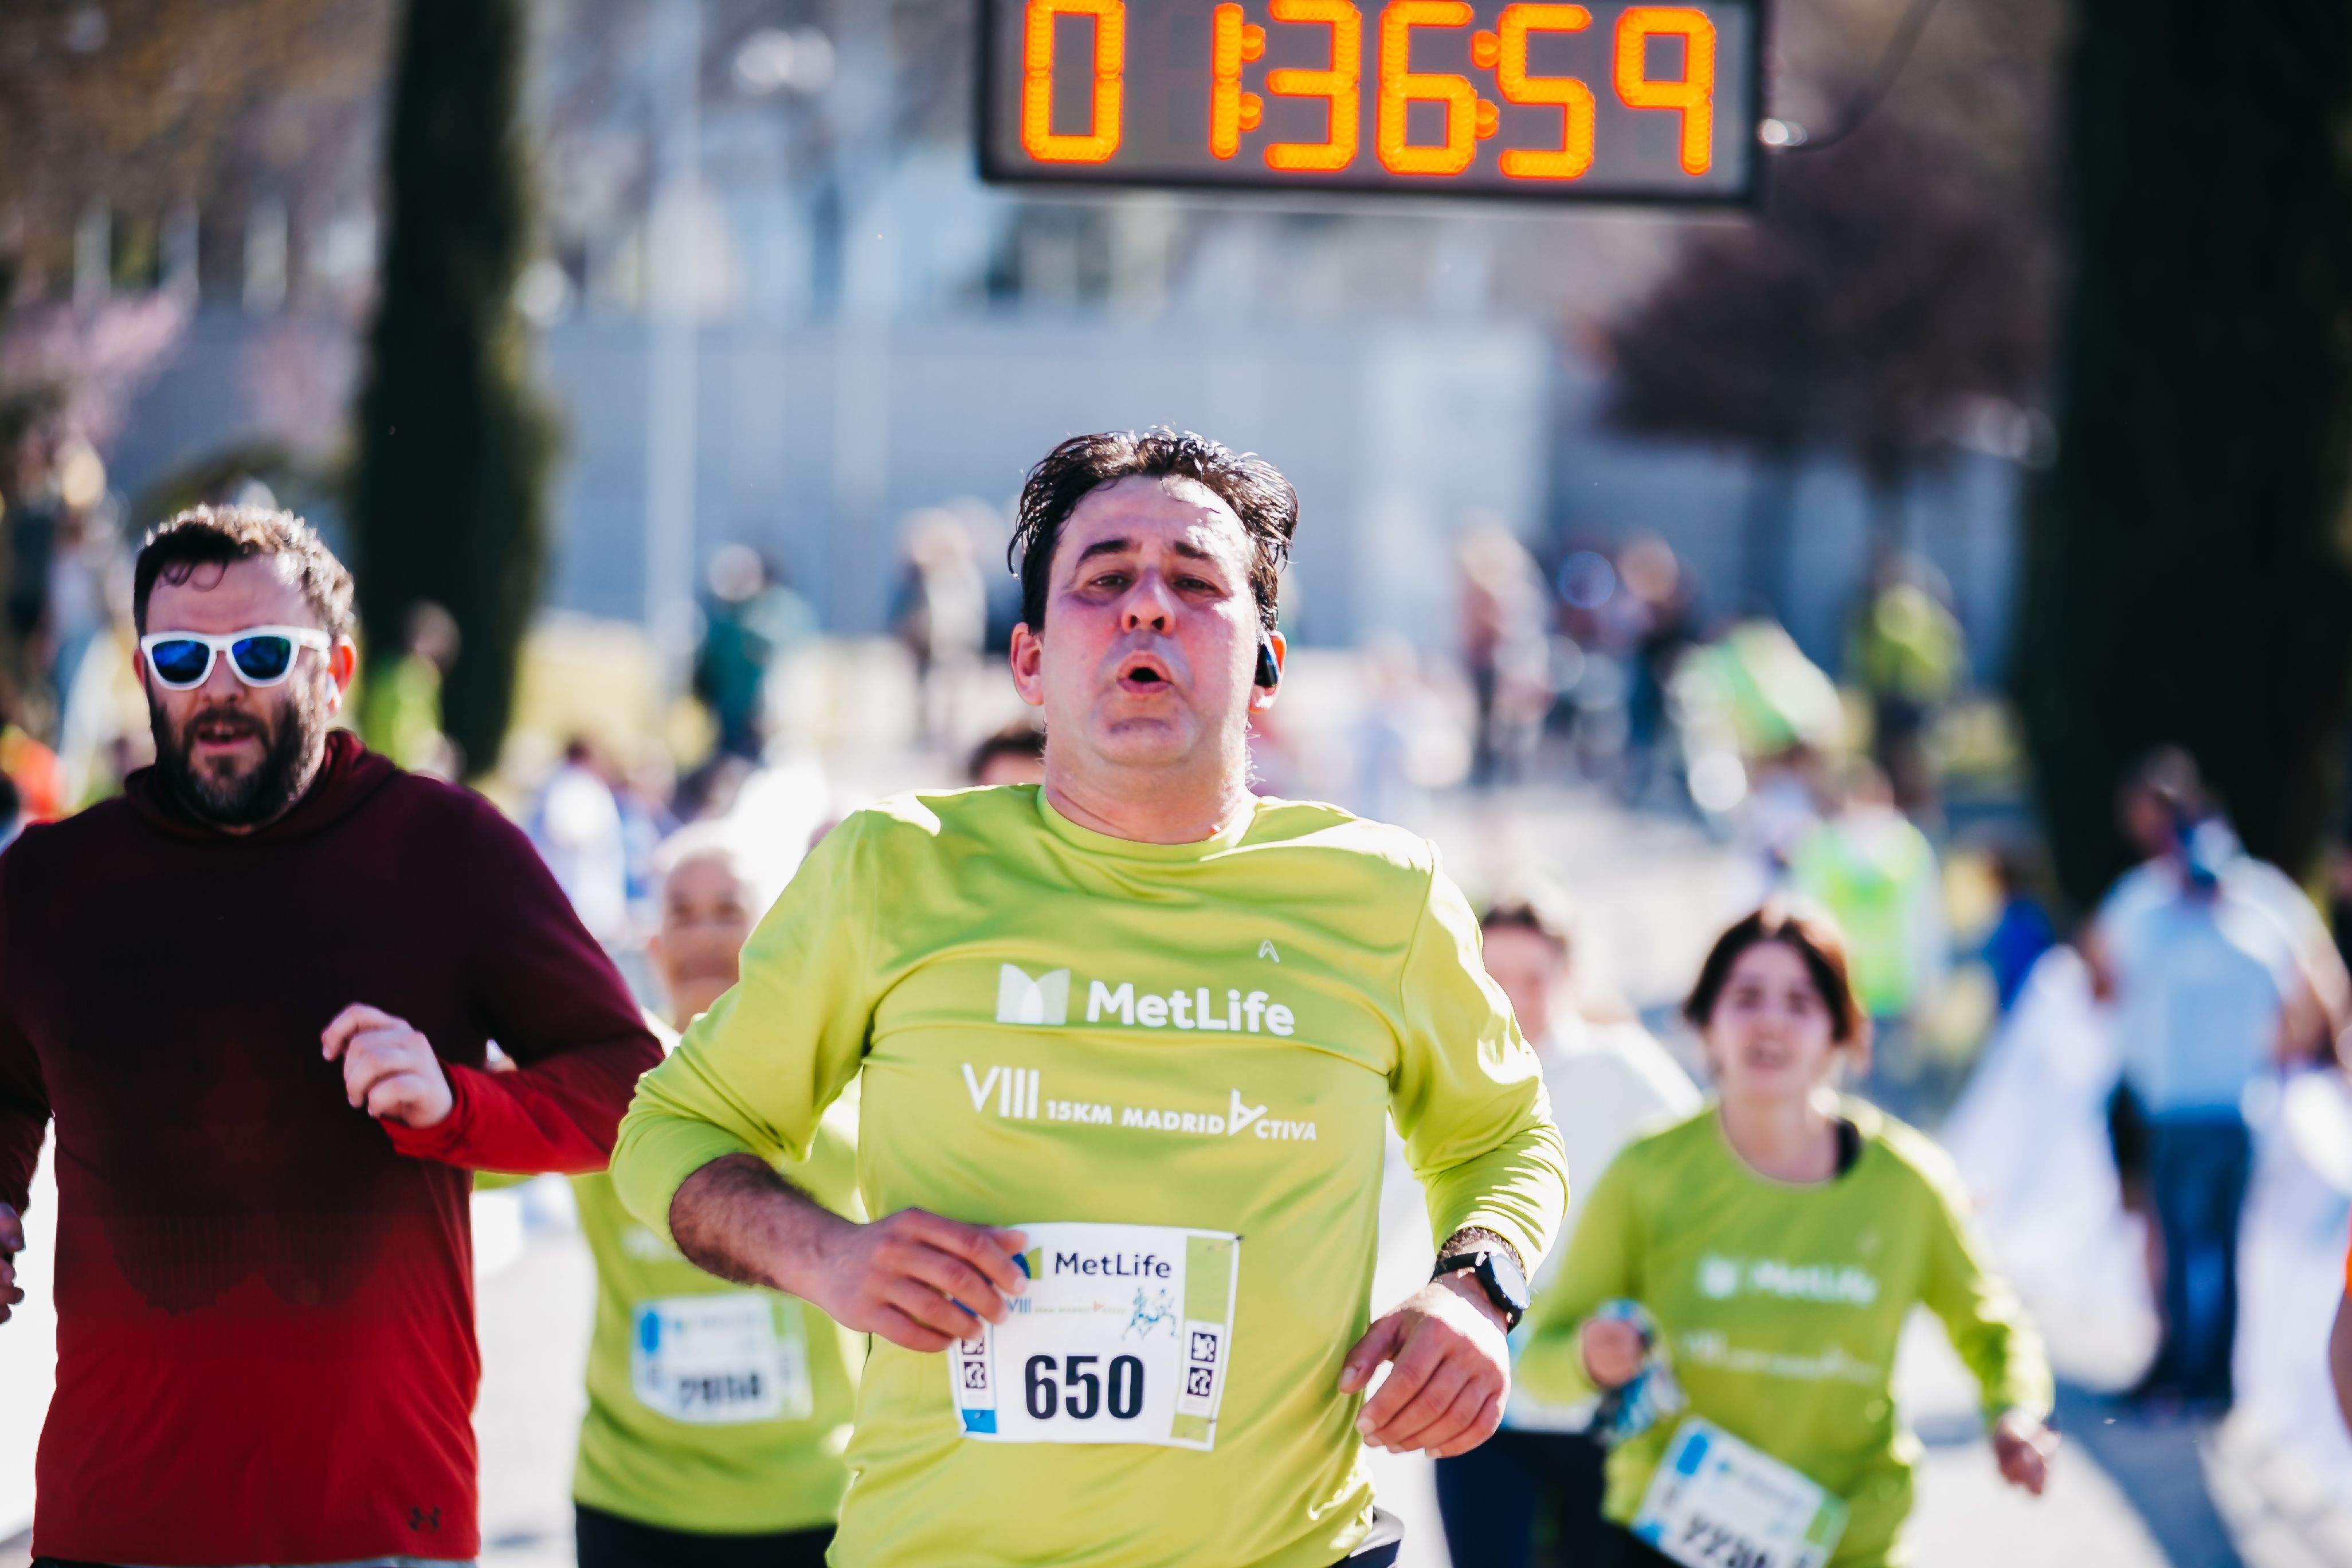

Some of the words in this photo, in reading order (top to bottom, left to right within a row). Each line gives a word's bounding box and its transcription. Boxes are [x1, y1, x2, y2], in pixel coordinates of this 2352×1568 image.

[1086, 980, 1296, 1036] MetLife
[962, 1063, 1040, 1120] VIII
[1045, 1100, 1113, 1125] 15KM
[1055, 1252, 1172, 1279] MetLife
[1024, 1353, 1144, 1420] 650
